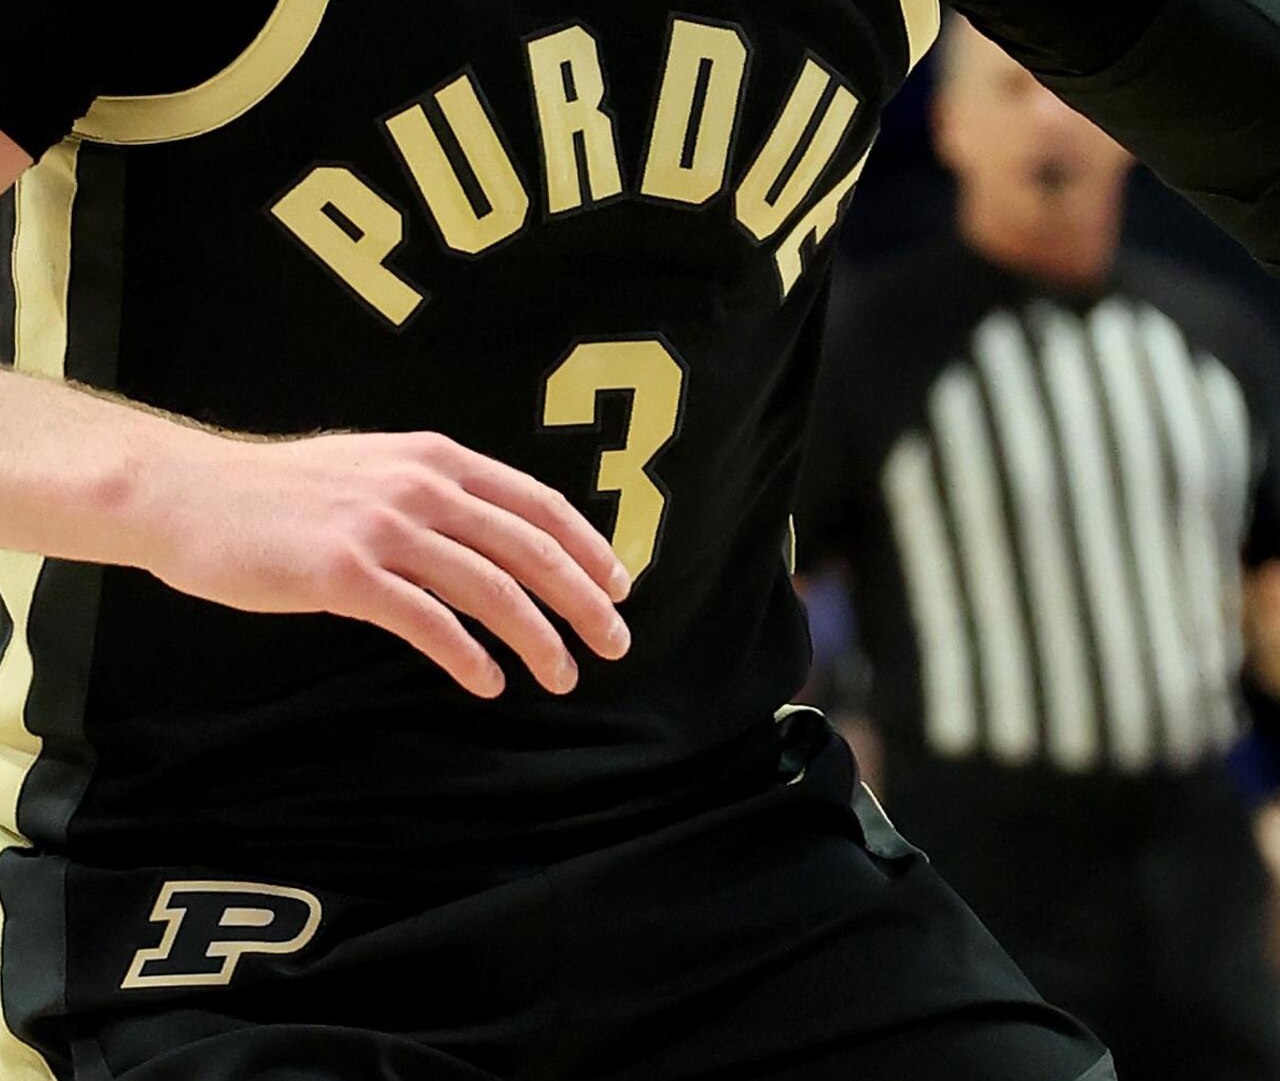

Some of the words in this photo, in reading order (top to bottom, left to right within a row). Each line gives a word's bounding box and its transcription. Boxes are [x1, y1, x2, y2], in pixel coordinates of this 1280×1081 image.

[267, 14, 880, 328] PURDUE
[541, 336, 687, 600] 3
[120, 880, 322, 989] P
